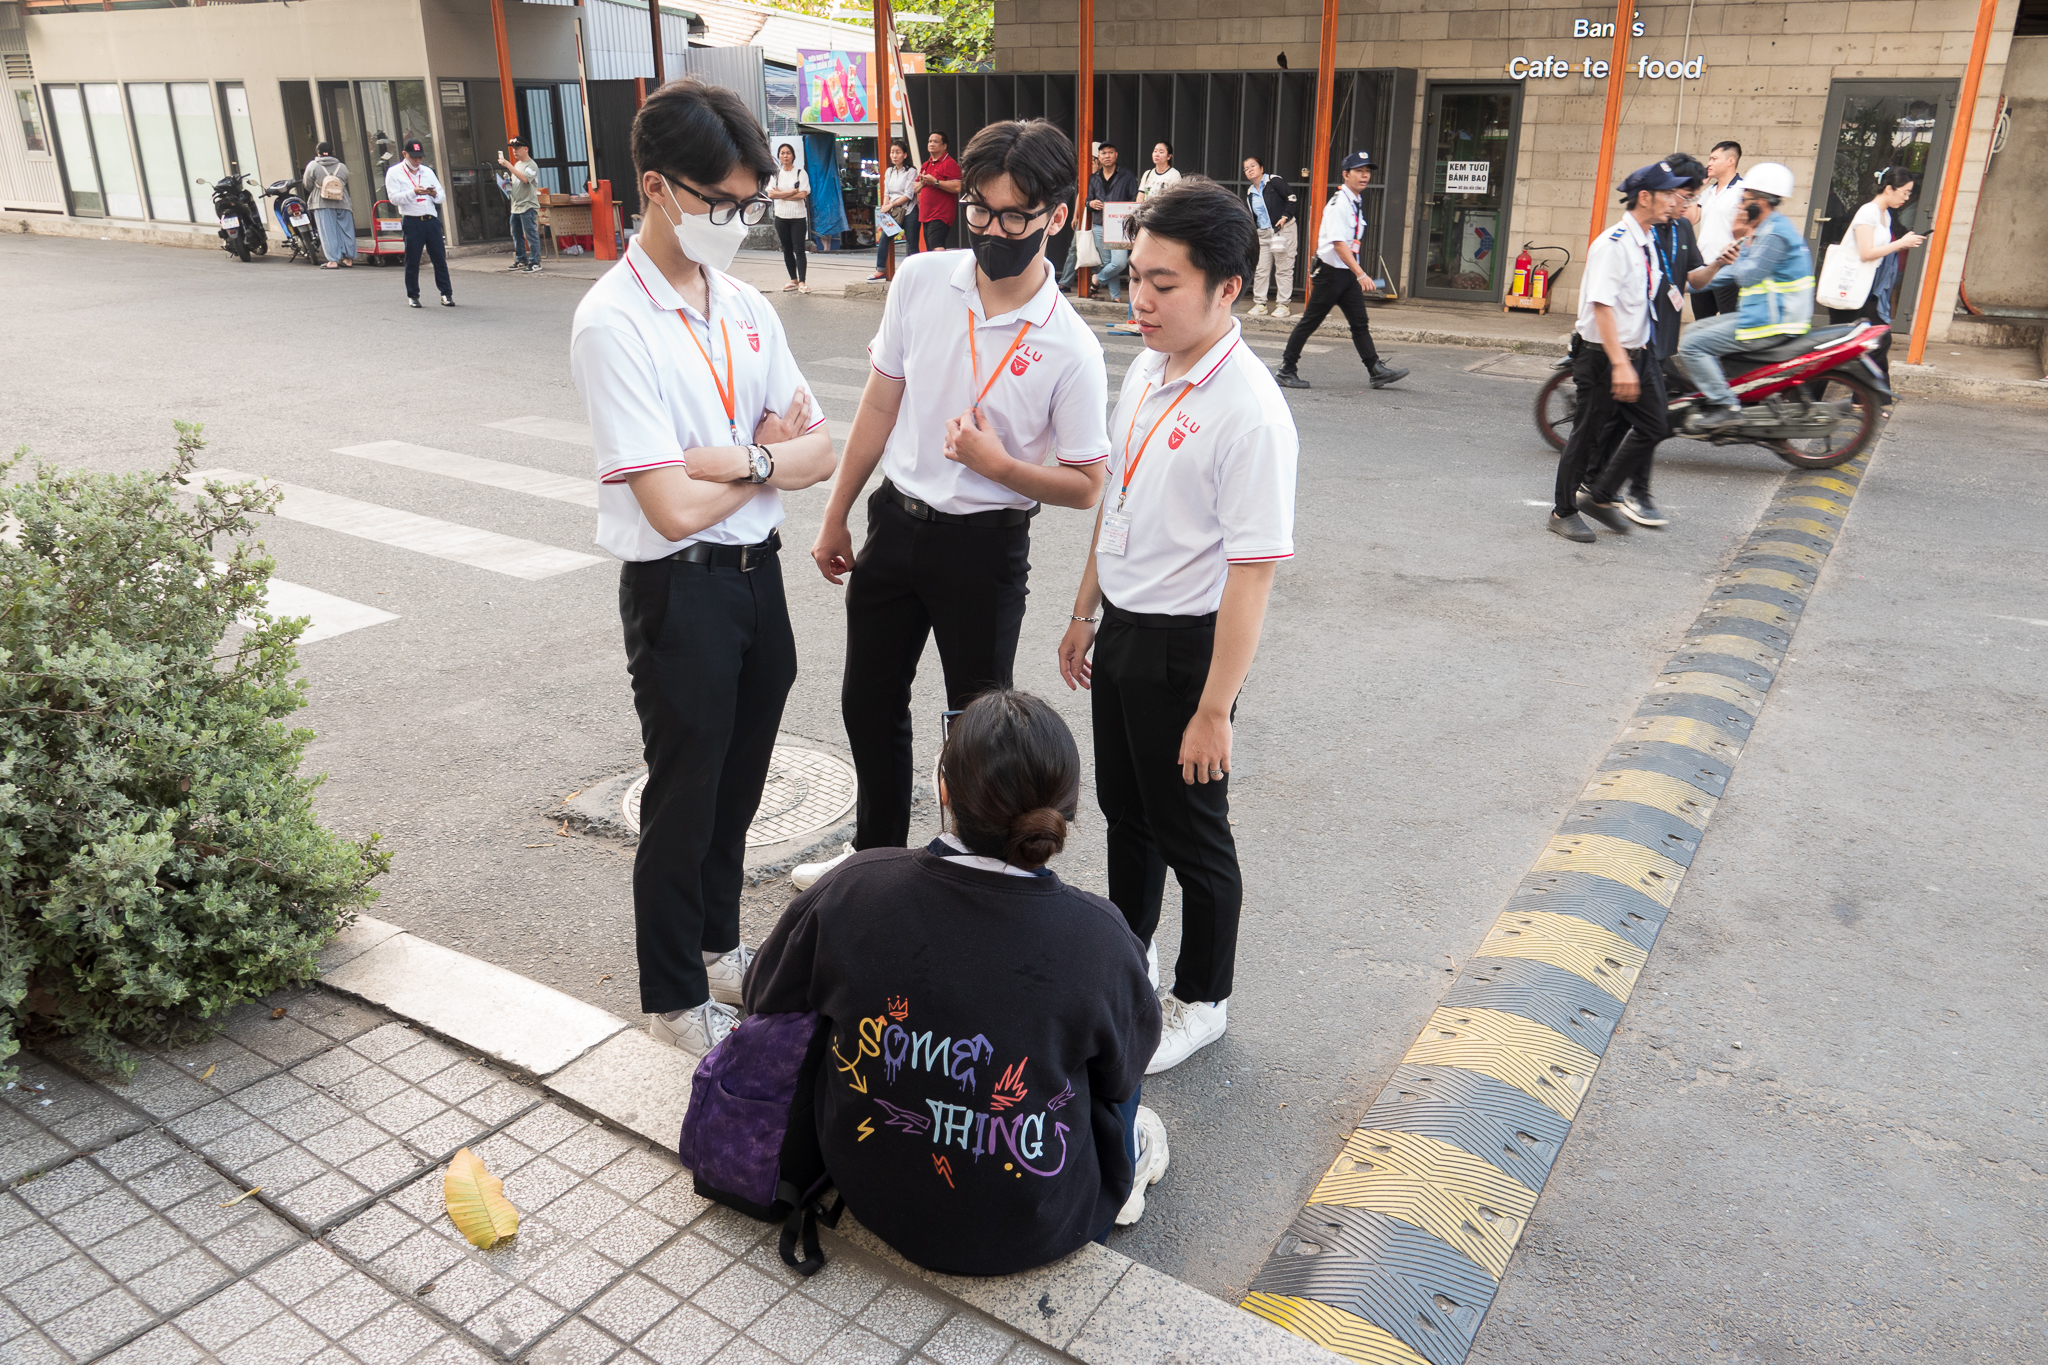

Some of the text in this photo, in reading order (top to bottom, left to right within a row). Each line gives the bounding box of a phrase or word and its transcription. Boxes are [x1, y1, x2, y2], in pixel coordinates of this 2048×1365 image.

[1573, 11, 1646, 38] Ban's
[1508, 55, 1704, 80] Cafe te food
[1448, 172, 1487, 182] BÁNH BAO
[1449, 162, 1488, 171] KEM TƯƠI
[735, 320, 753, 330] VL
[1015, 343, 1043, 362] VLU
[1176, 410, 1201, 434] VLU
[847, 1015, 994, 1090] SOME
[926, 1098, 1051, 1166] THING
